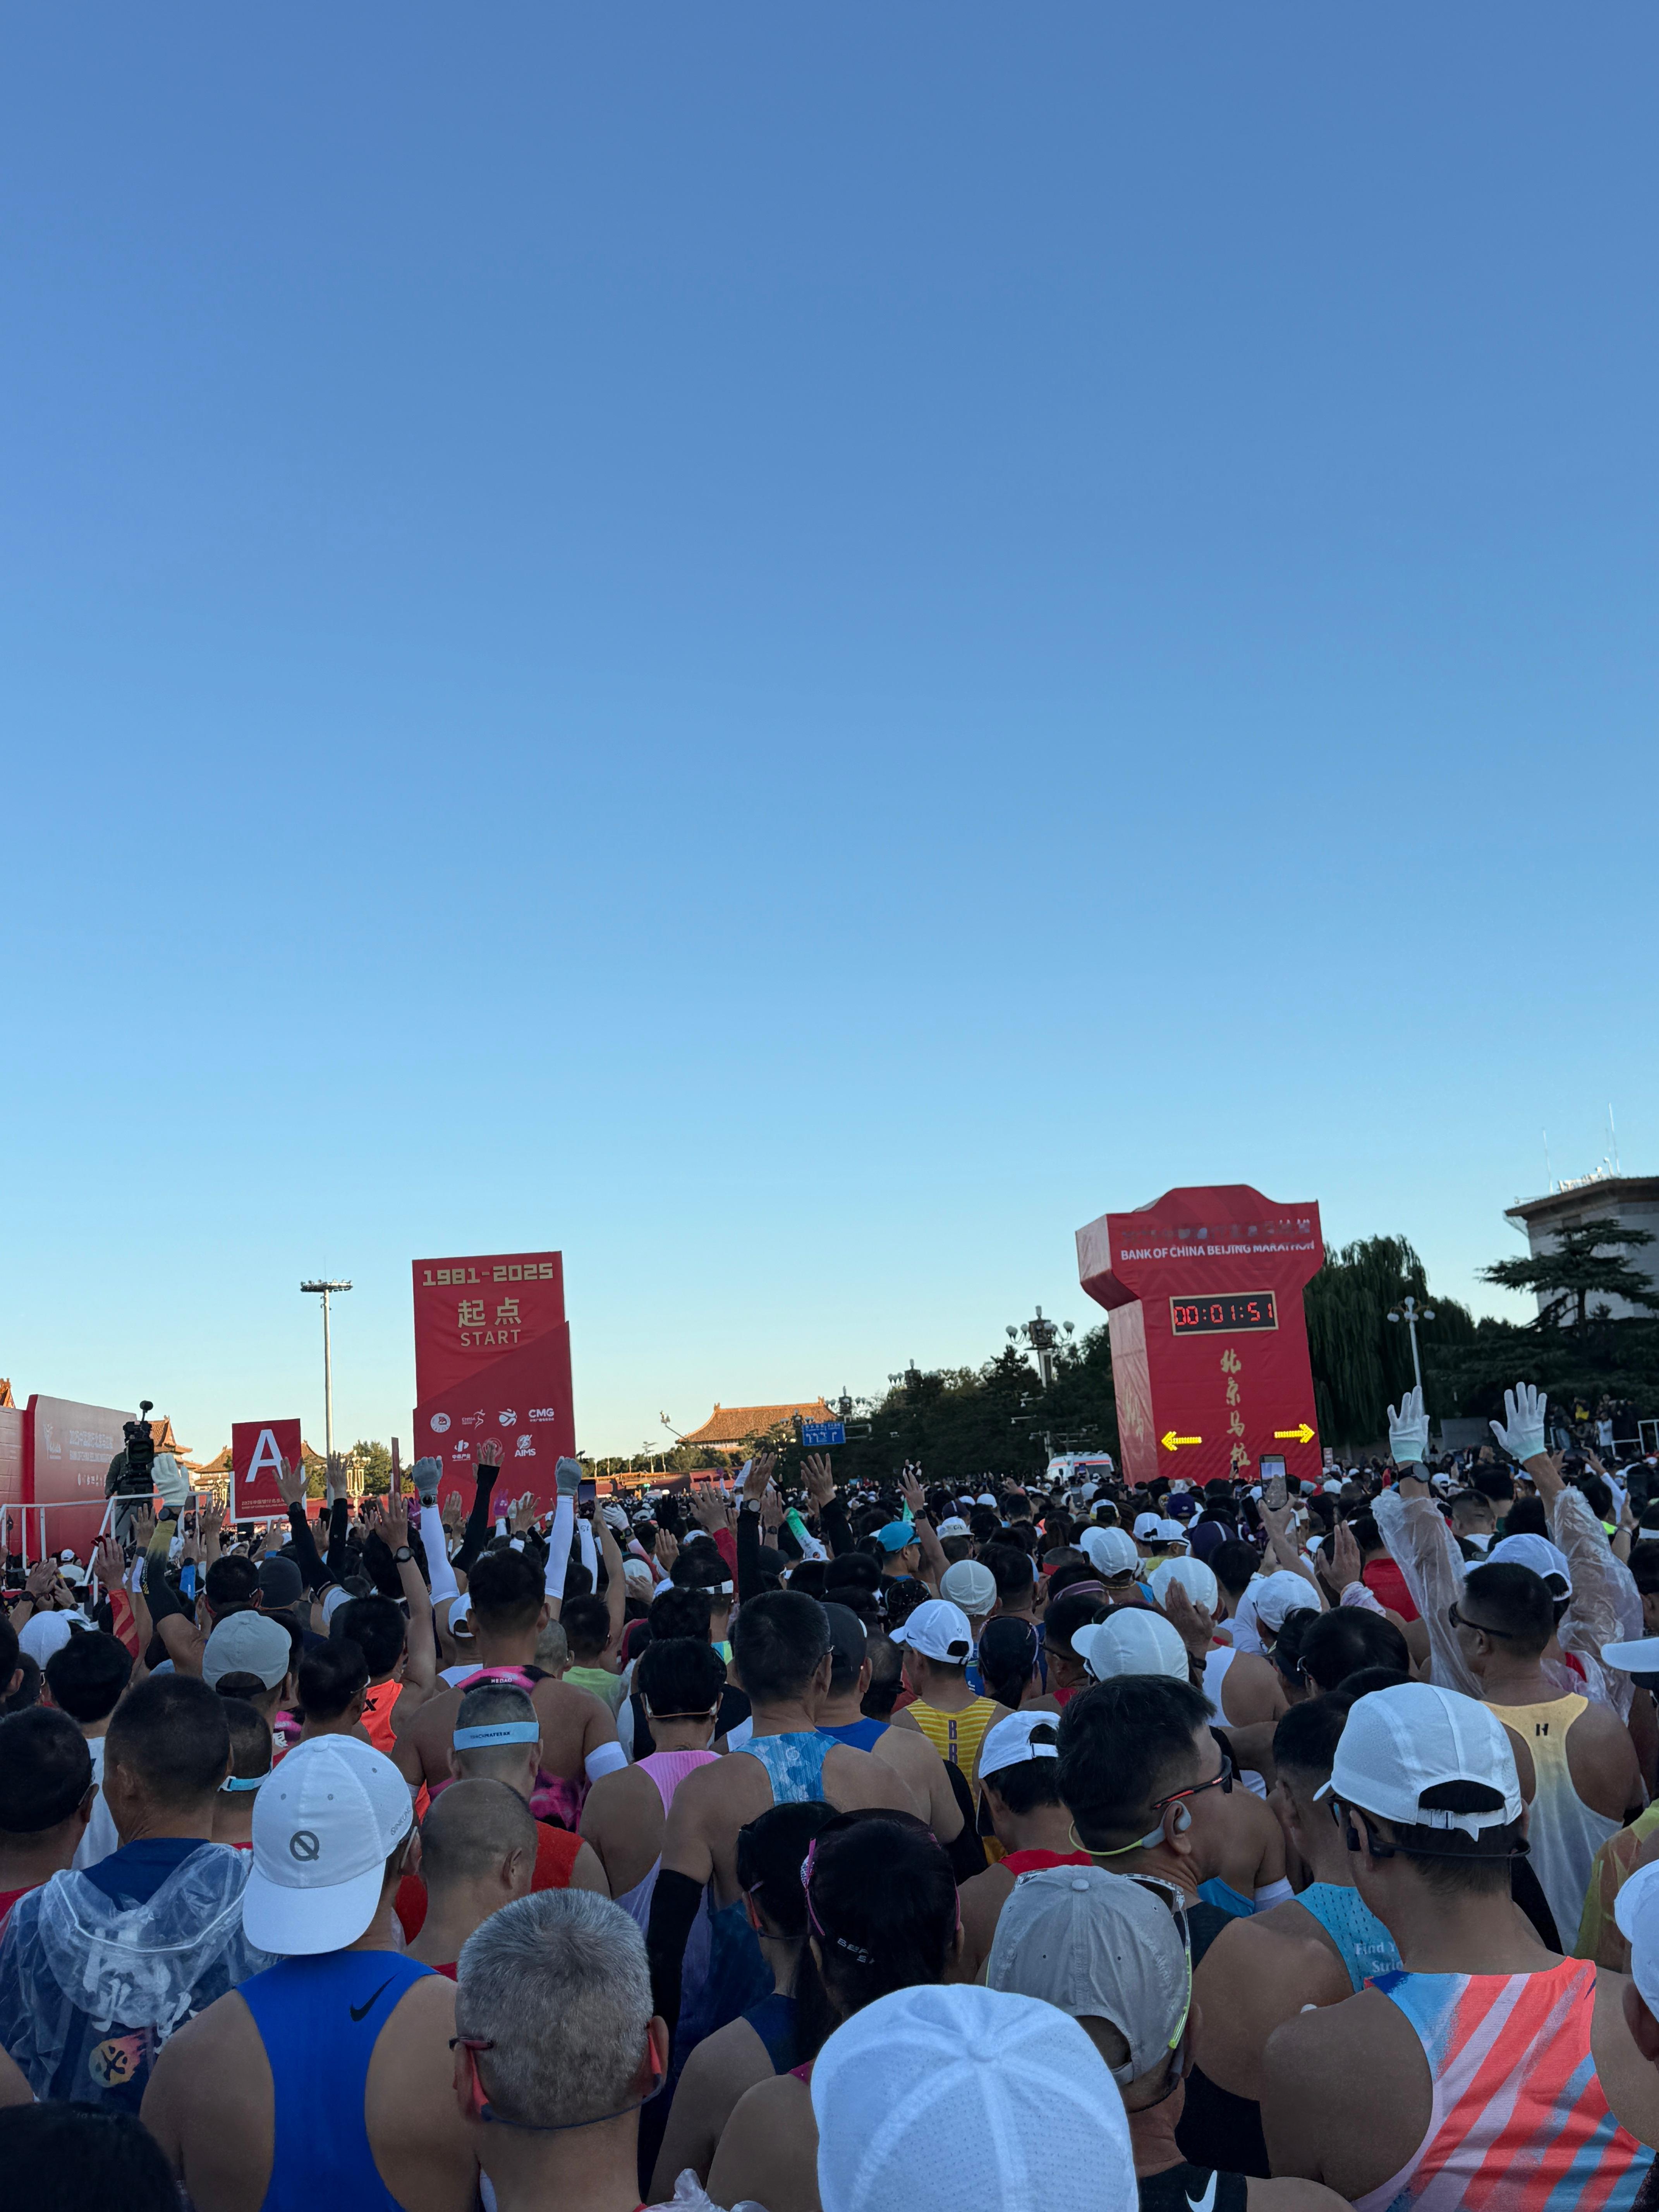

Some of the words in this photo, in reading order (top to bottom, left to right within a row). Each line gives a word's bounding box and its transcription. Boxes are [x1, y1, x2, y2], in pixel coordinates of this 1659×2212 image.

[1121, 1248, 1152, 1261] BANK
[1153, 1247, 1168, 1258] OF
[1170, 1245, 1205, 1258] CHINA
[1207, 1245, 1251, 1255] BEIJING
[422, 1263, 553, 1286] 1981-2025
[458, 1297, 522, 1328] 起点
[1173, 1302, 1273, 1326] 00:01:51
[461, 1329, 521, 1347] START
[528, 1408, 555, 1418] CMG
[1221, 1348, 1252, 1482] 北京马拉
[245, 1429, 283, 1483] A
[515, 1448, 536, 1458] AIMS
[1355, 1942, 1384, 1955] Find
